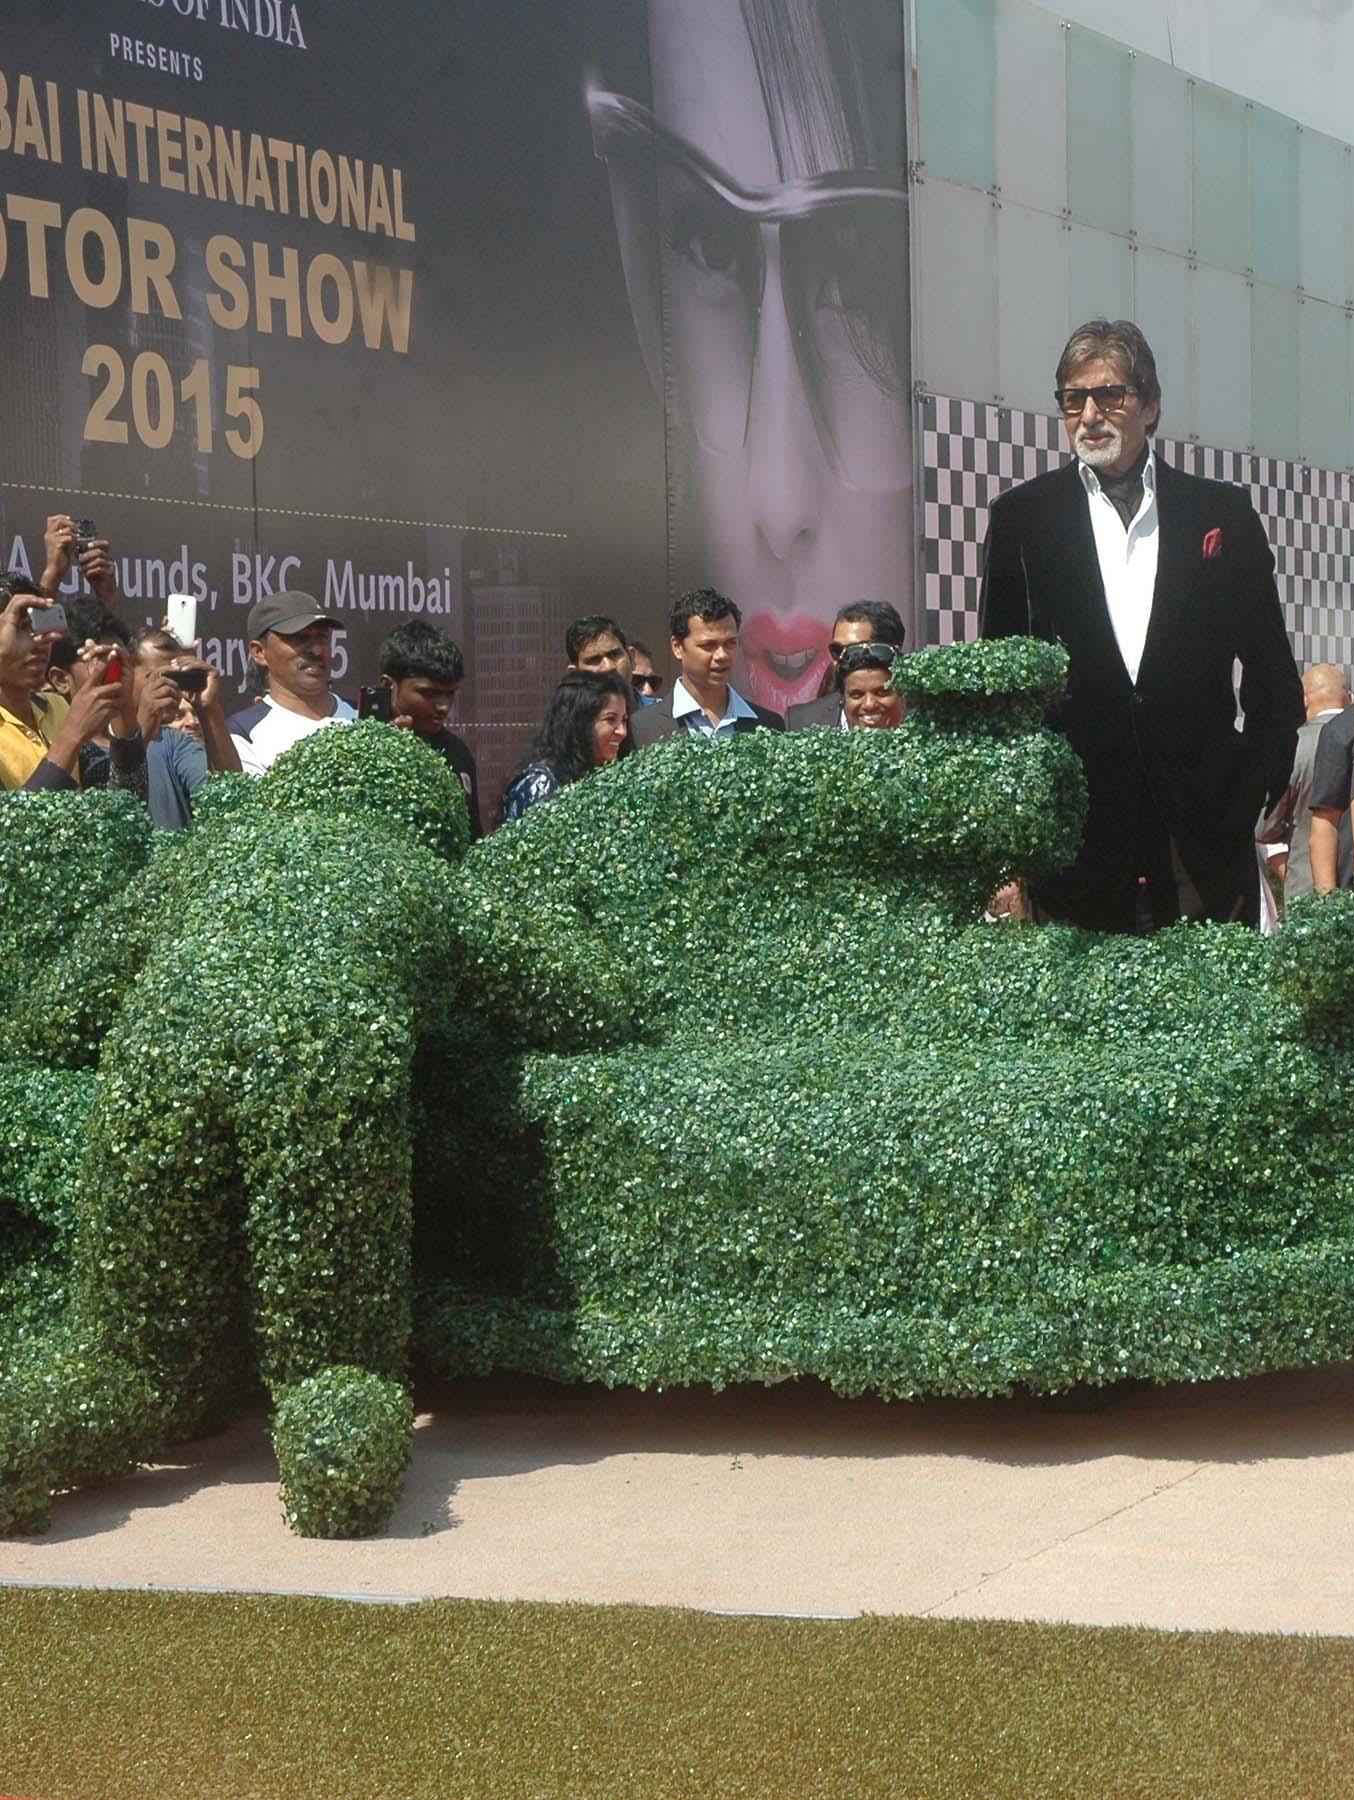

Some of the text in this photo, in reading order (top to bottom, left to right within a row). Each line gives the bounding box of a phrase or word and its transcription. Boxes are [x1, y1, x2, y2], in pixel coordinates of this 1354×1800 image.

[110, 32, 204, 81] PRESENTS
[77, 88, 416, 242] INTERNATIONAL
[0, 193, 415, 354] TOR SHOW
[80, 344, 264, 460] 2015
[58, 544, 218, 611] unds,
[323, 558, 451, 614] Mumbai
